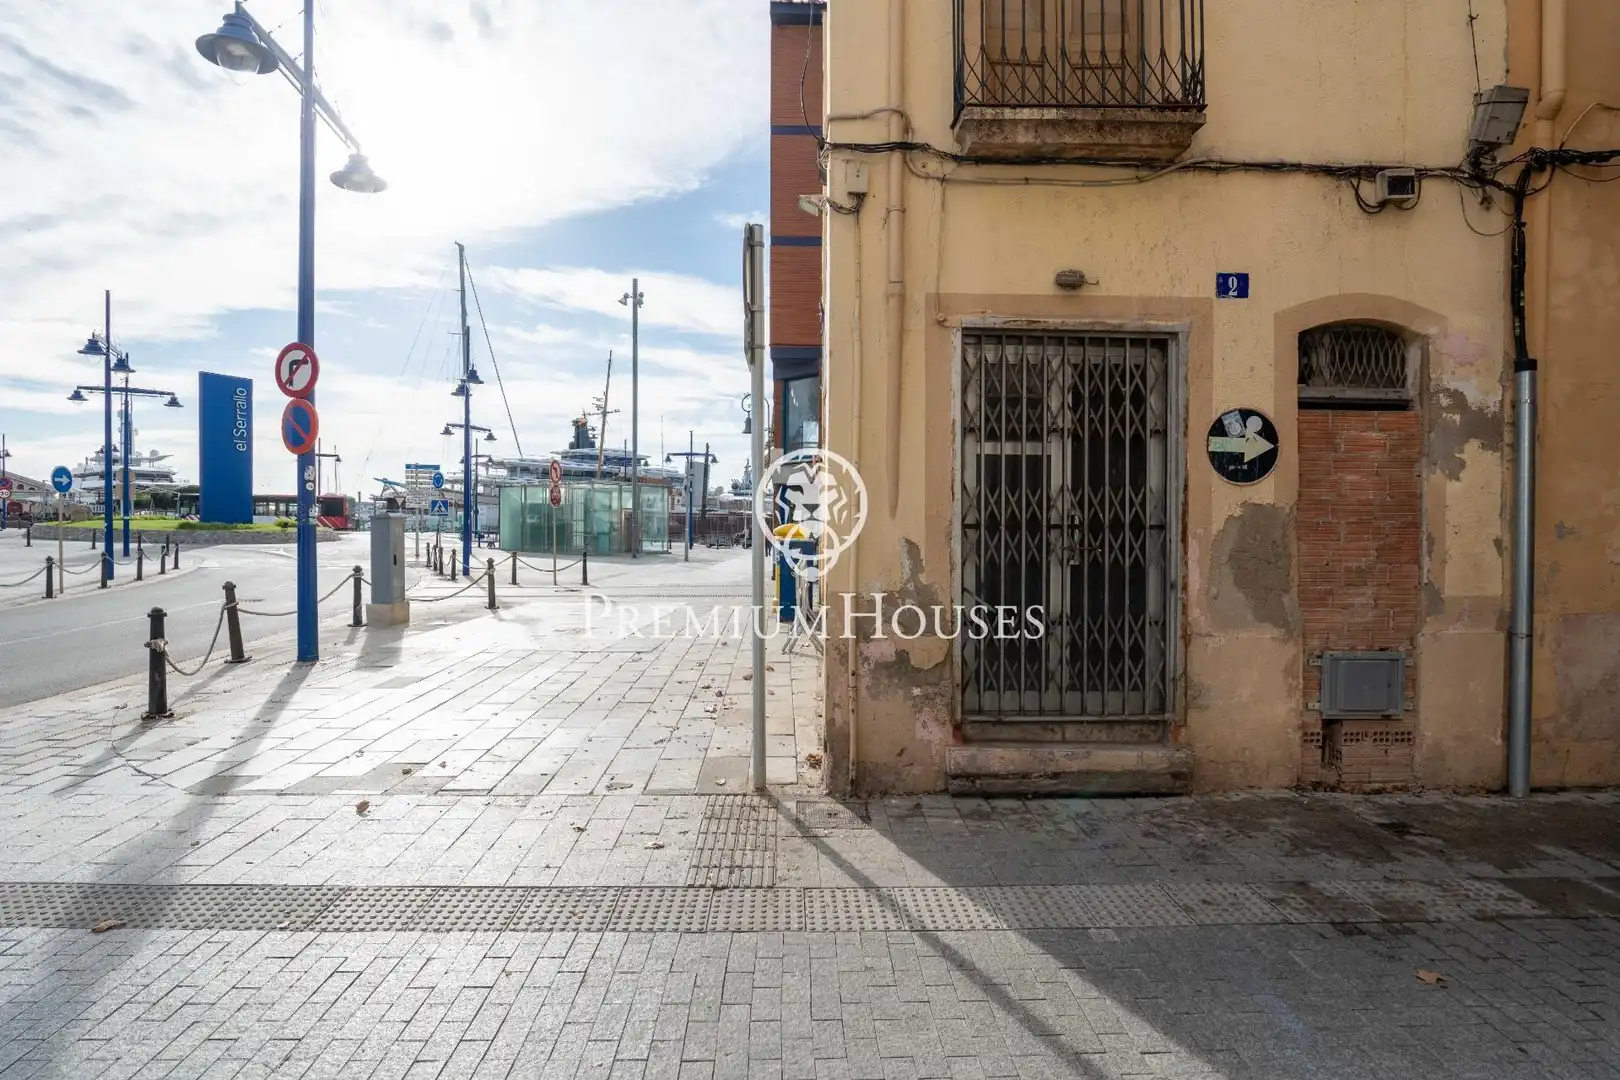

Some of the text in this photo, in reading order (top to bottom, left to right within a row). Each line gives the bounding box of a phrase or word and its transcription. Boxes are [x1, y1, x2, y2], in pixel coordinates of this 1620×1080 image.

[1228, 276, 1238, 296] 2
[233, 387, 247, 452] el Serrallo
